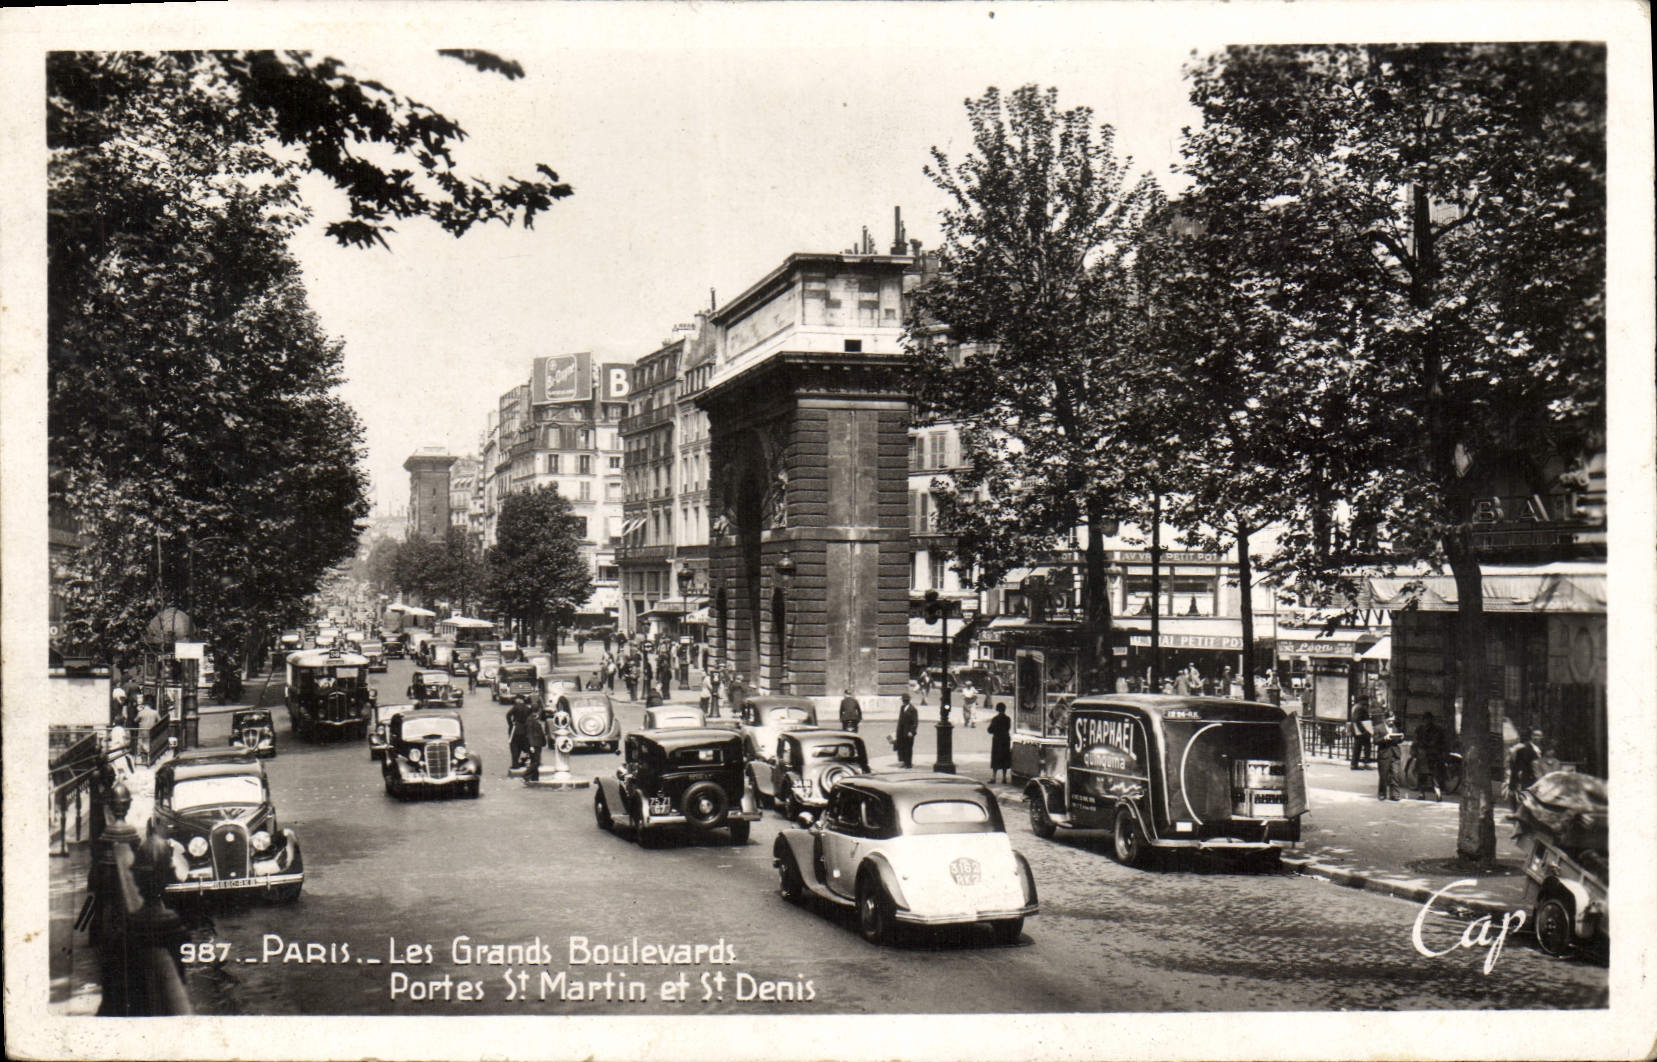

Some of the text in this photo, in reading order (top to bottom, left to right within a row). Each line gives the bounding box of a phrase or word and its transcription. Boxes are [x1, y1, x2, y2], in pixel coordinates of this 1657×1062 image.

[610, 368, 629, 398] B
[1166, 552, 1194, 561] PETIT
[1198, 552, 1218, 561] POT
[1181, 636, 1215, 648] PETIT
[1089, 718, 1137, 761] RAPHAËL
